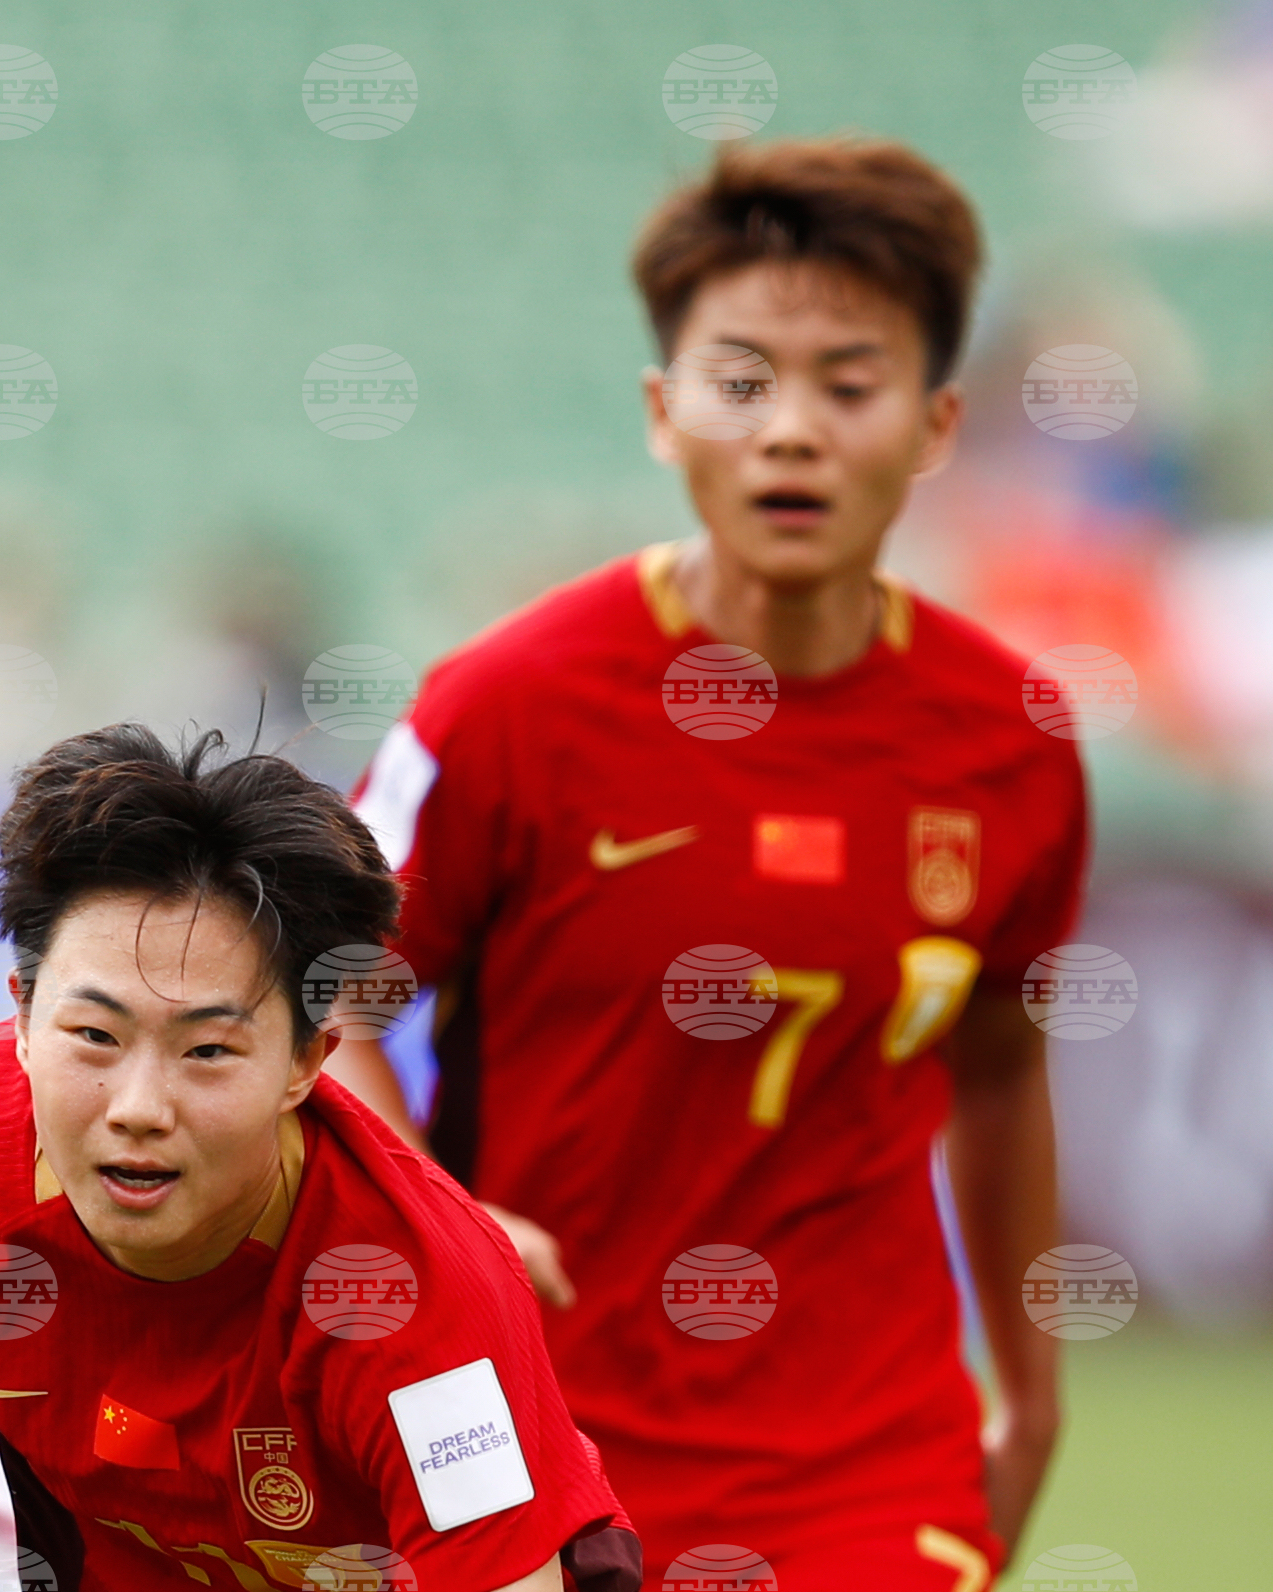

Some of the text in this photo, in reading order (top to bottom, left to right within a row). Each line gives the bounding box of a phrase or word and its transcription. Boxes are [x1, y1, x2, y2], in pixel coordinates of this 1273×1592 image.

[747, 967, 845, 1130] 7
[420, 1431, 511, 1474] FEARLESS
[429, 1421, 496, 1456] DREAM
